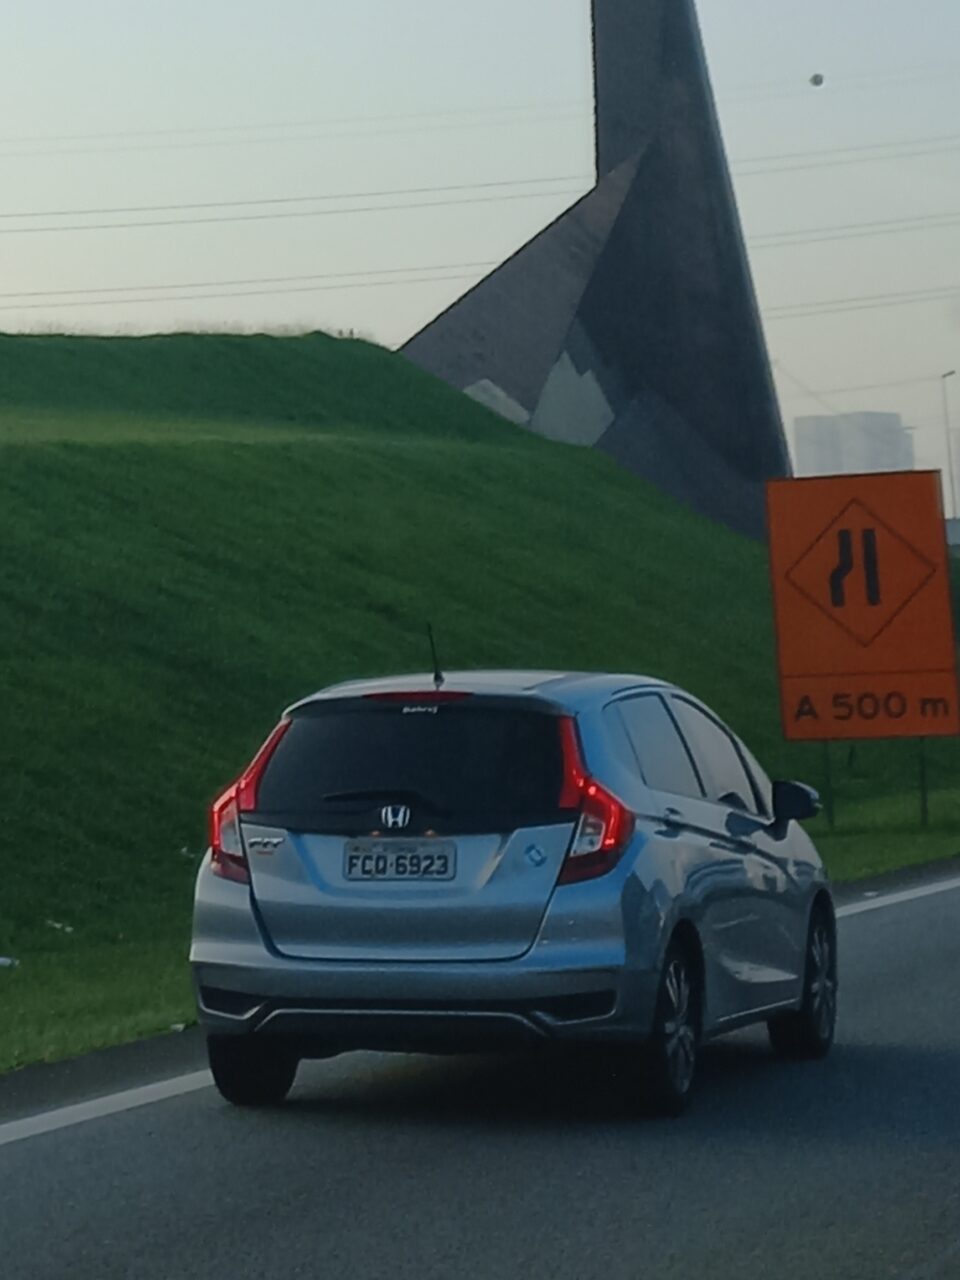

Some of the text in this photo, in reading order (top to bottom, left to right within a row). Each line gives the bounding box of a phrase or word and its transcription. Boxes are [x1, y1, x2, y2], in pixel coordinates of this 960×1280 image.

[794, 691, 950, 722] A 500 m
